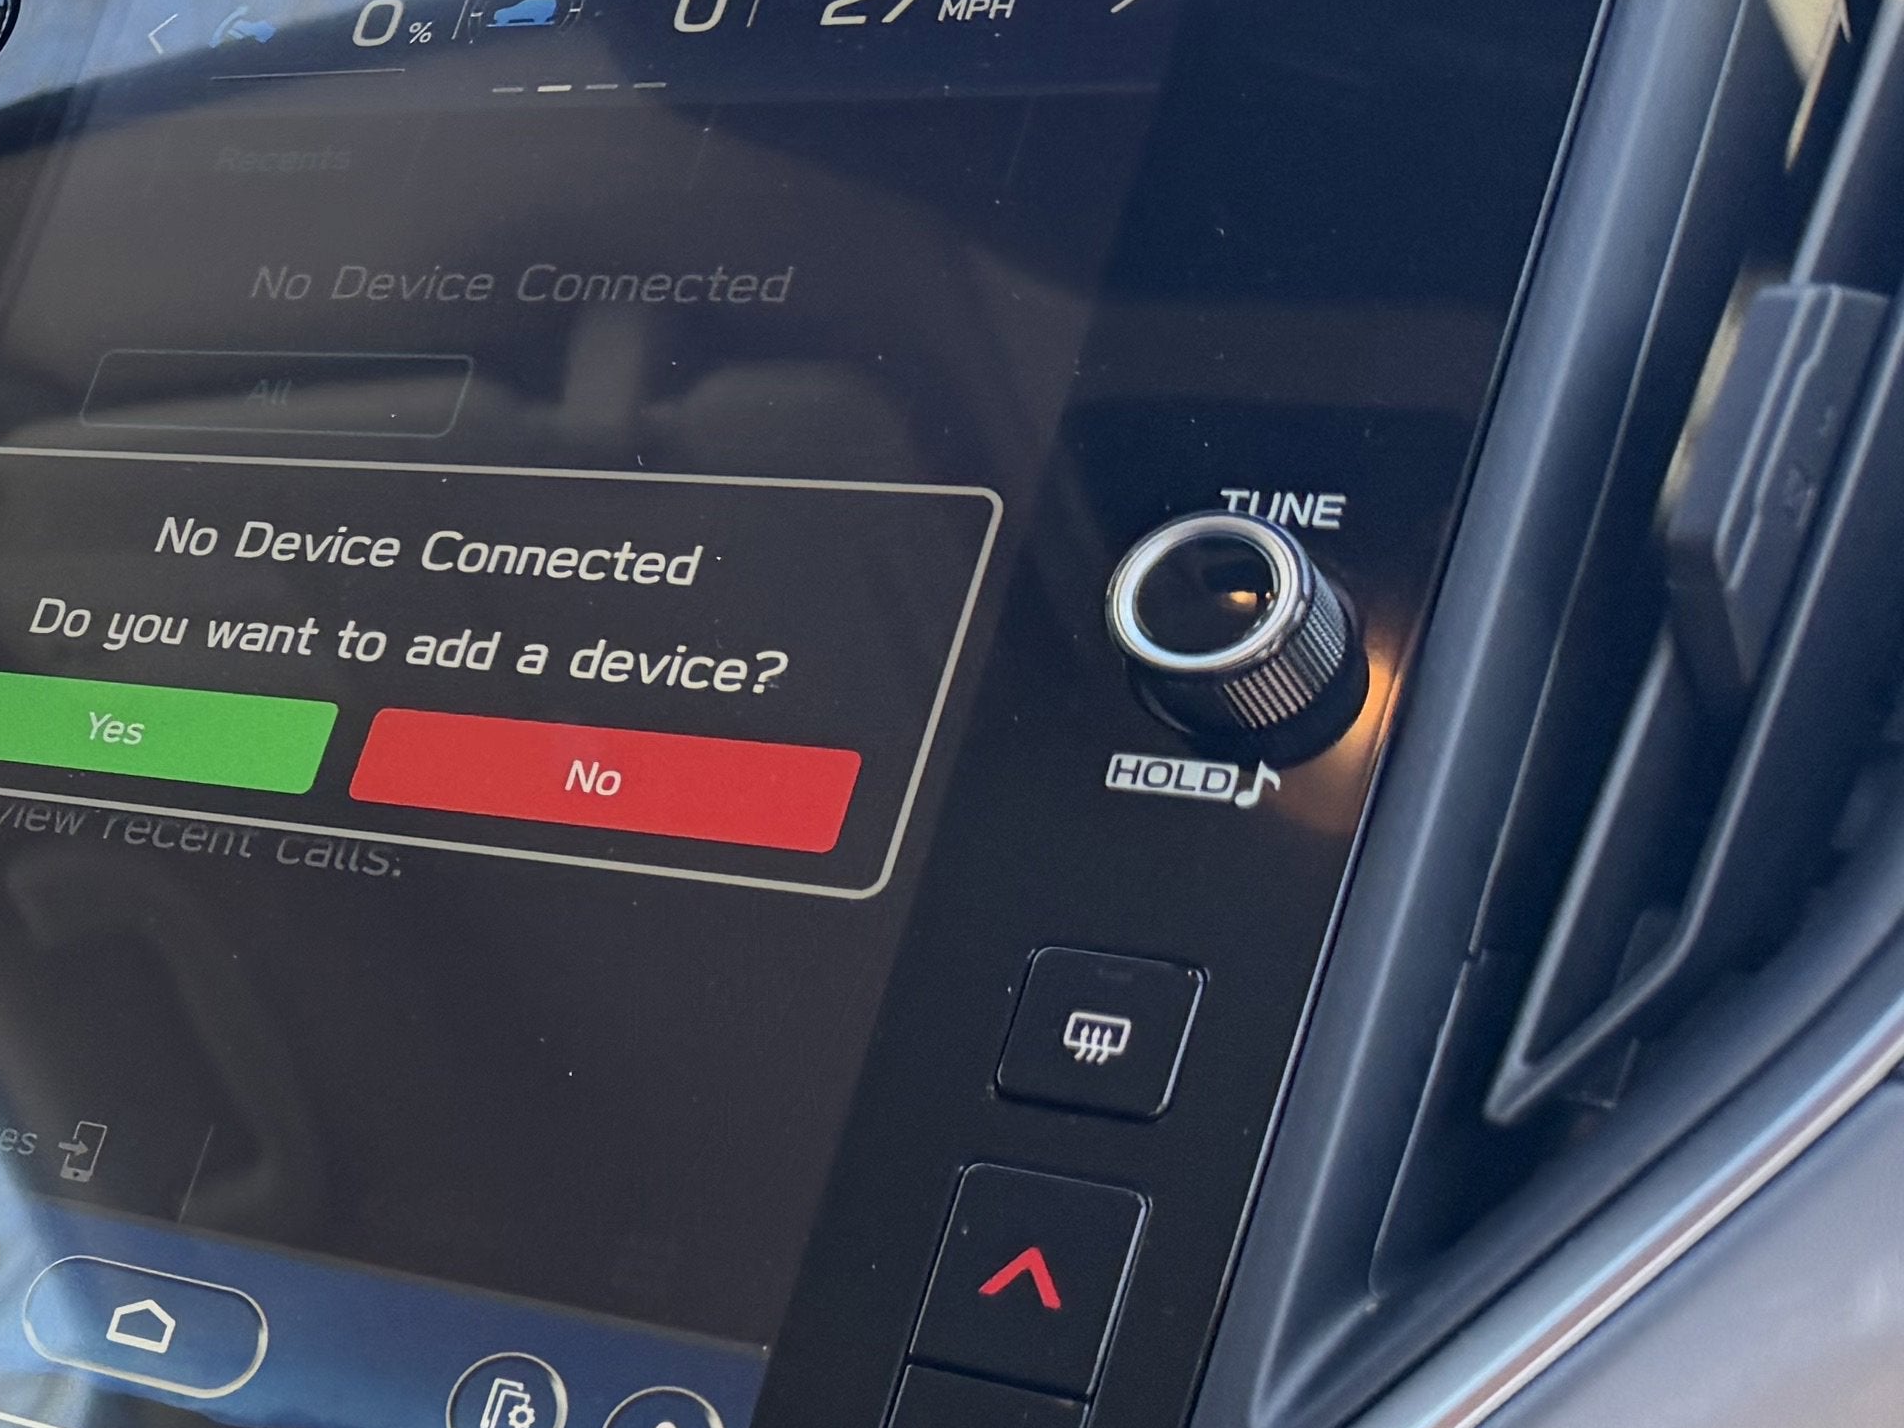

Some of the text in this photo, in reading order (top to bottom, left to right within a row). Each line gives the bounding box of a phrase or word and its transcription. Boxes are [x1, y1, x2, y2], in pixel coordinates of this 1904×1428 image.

[249, 263, 796, 304] No Device Connected
[1219, 488, 1347, 530] TUNE
[153, 514, 704, 590] No Device Connected
[29, 594, 790, 697] Do you want to add a device?
[84, 709, 146, 749] Yes
[563, 757, 624, 800] No
[1108, 757, 1237, 798] HOLD
[100, 810, 253, 860] recent
